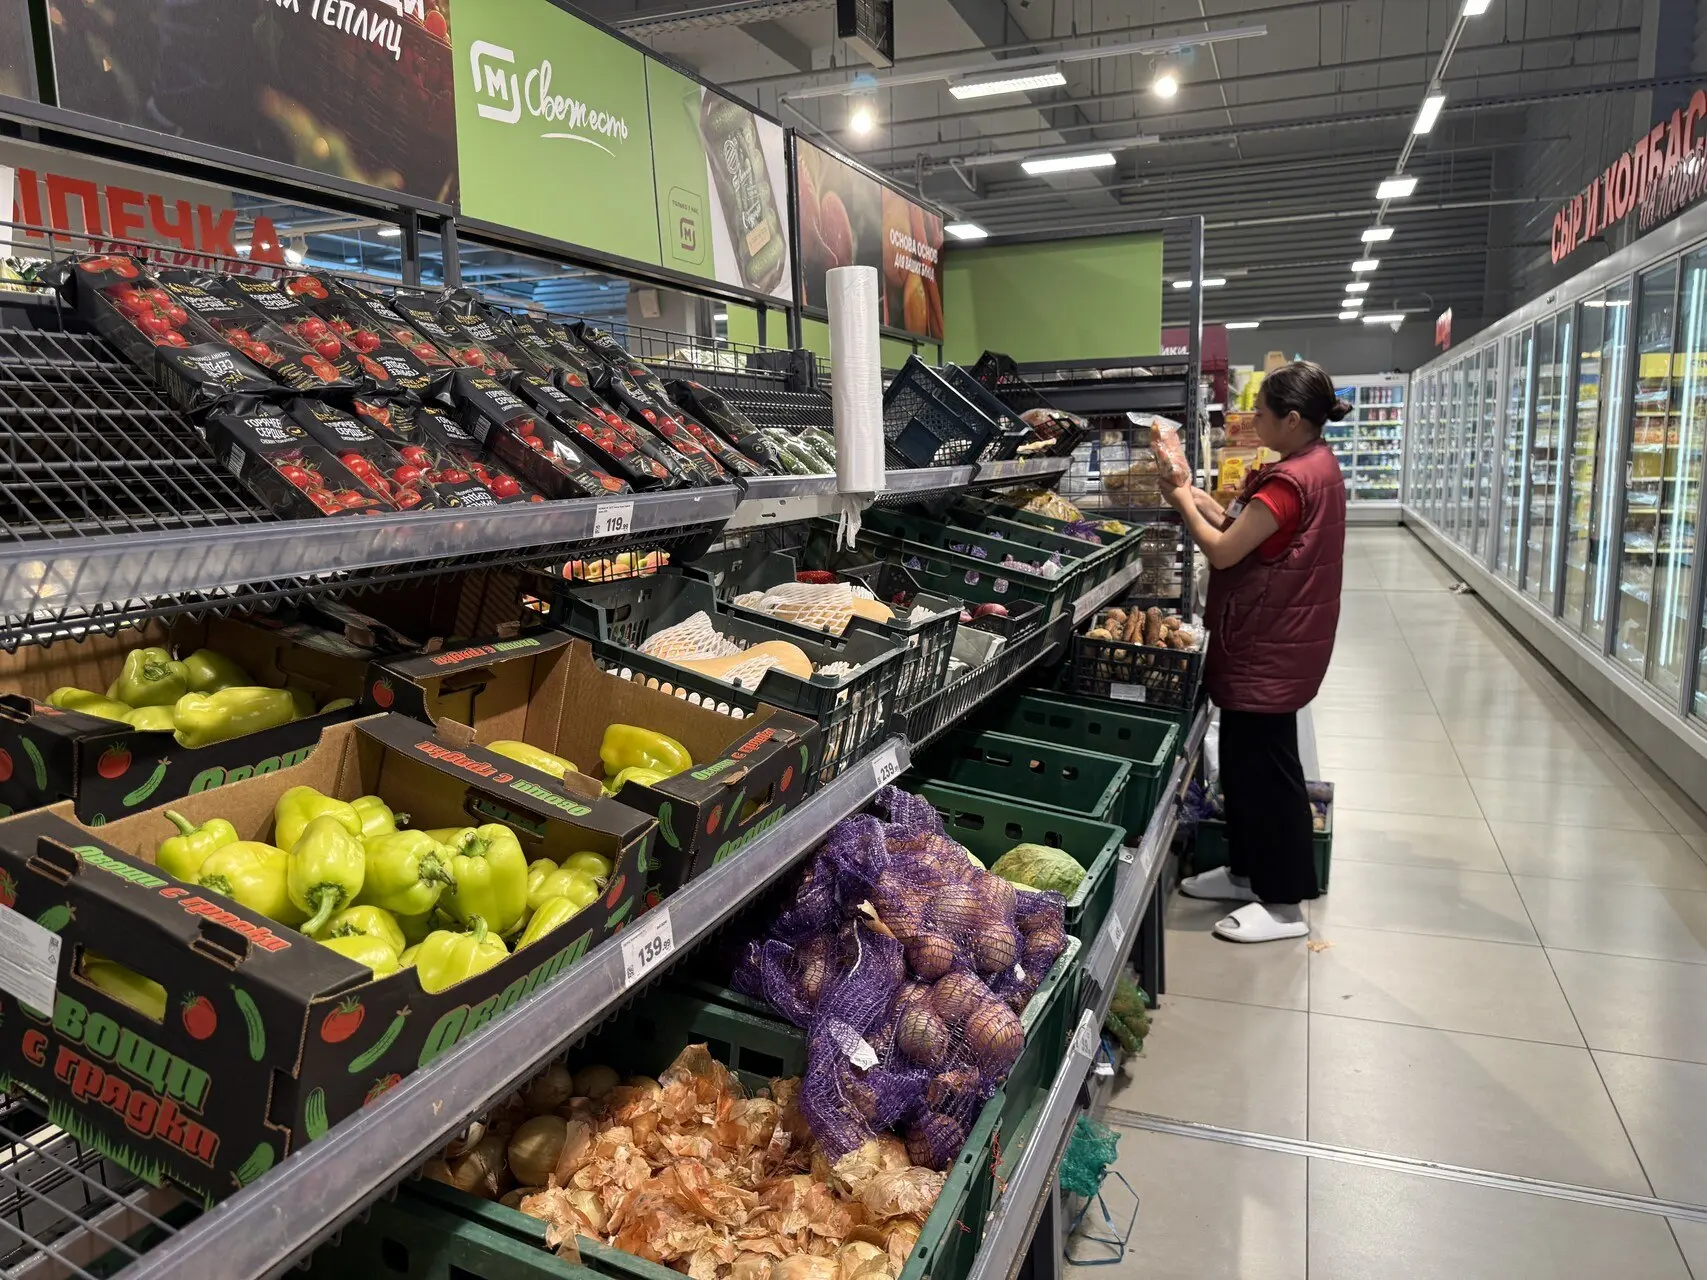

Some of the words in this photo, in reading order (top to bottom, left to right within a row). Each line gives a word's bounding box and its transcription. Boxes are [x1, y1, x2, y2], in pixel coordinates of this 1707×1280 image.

[525, 59, 628, 145] Свежесть
[1551, 194, 1583, 265] СЫР
[1584, 176, 1600, 242] И
[1602, 89, 1707, 229] КОЛБАС
[889, 227, 917, 255] ОСНОВА
[917, 241, 938, 264] ОСНОВ
[244, 418, 283, 429] ГОРЯЧЕЕ
[255, 427, 290, 439] СЕРДЦЕ
[414, 740, 498, 777] грядки
[493, 772, 513, 783] с
[510, 779, 592, 816] Овощи
[73, 845, 169, 888] Овощи
[158, 887, 190, 899] с
[178, 896, 292, 952] грядки
[17, 989, 211, 1116] вощи
[22, 1029, 48, 1067] с
[54, 1045, 220, 1168] грядки
